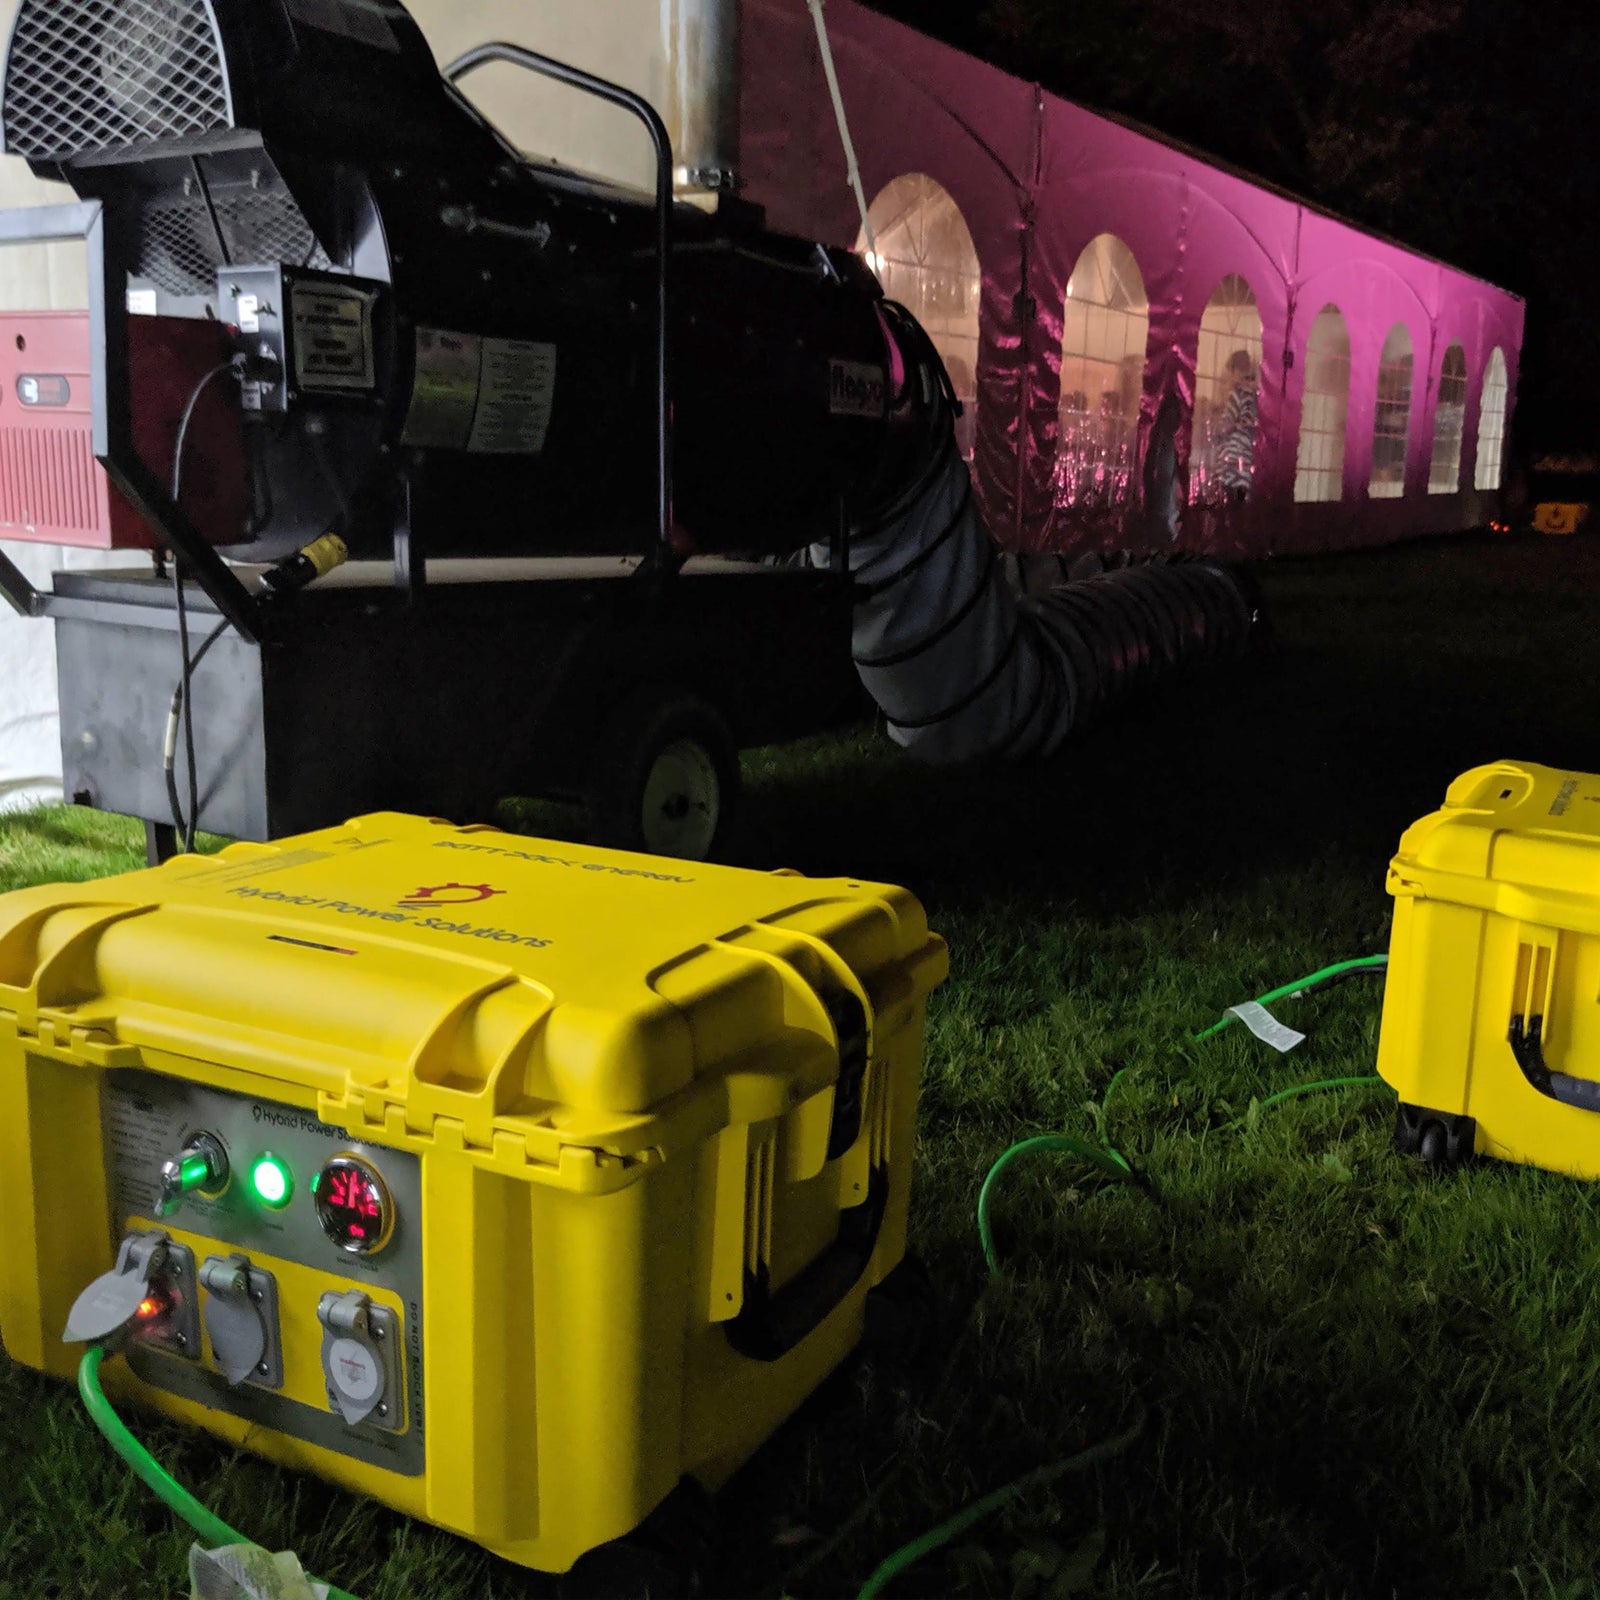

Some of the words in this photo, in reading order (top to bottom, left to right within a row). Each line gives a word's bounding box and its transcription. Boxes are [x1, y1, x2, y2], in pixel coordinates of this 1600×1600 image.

[226, 886, 327, 906] Hybrid
[317, 900, 418, 922] Power
[414, 917, 553, 947] Solutions
[263, 1109, 298, 1128] Hybrid
[300, 1116, 335, 1137] Power
[410, 1302, 418, 1321] DO
[411, 1325, 420, 1352] NOT
[412, 1356, 421, 1397] BLOCK
